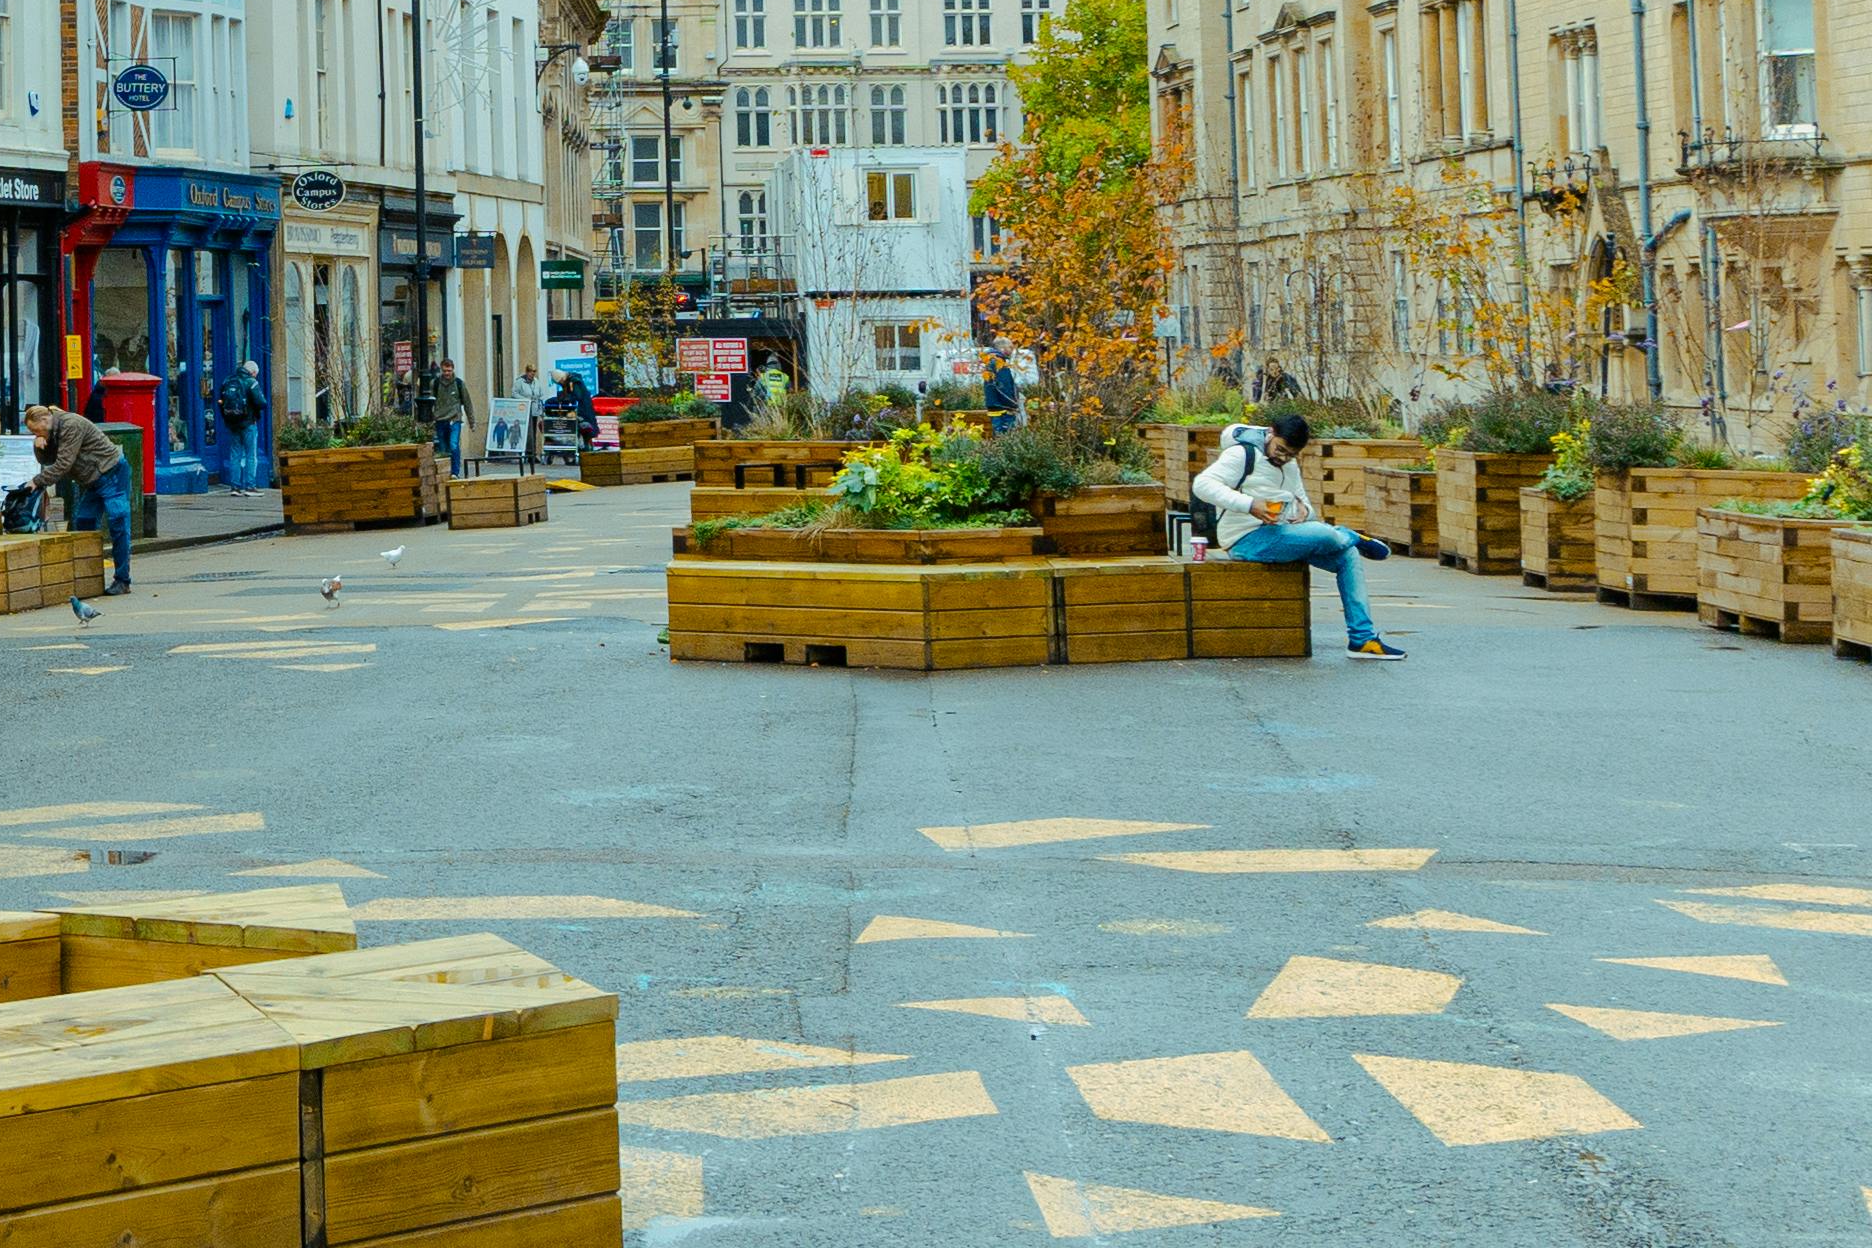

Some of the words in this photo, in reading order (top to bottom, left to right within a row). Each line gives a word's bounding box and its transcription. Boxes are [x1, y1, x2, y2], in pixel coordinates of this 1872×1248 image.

[134, 73, 147, 81] THE
[116, 82, 166, 93] BUTTERY
[298, 172, 338, 186] Oxford
[14, 177, 39, 200] Store
[296, 187, 337, 198] Campus
[190, 183, 218, 206] Oxford
[223, 187, 251, 213] Campus
[300, 196, 338, 209] Stores
